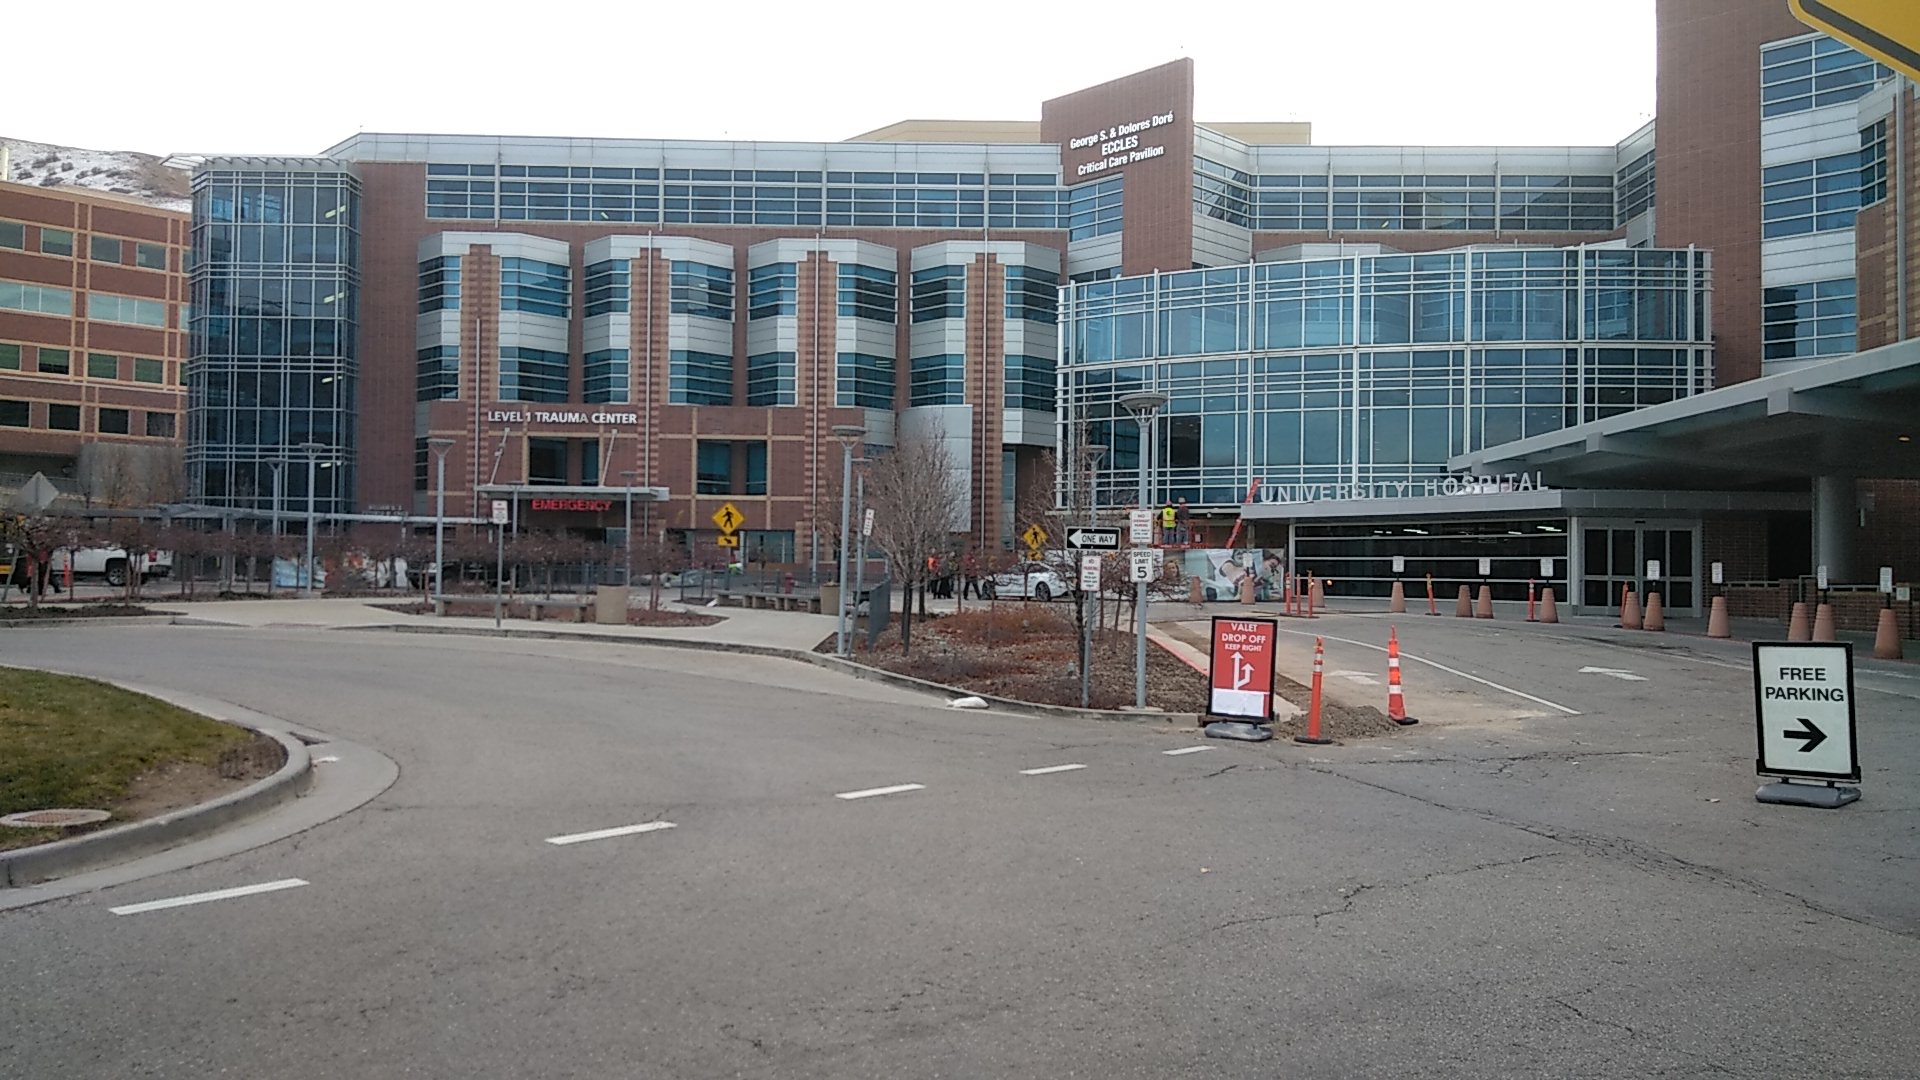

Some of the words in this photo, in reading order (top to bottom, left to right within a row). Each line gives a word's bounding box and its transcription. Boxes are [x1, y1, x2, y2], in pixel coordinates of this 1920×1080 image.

[1070, 134, 1099, 150] George
[1100, 130, 1108, 141] S.
[1110, 127, 1117, 139] &
[1118, 119, 1151, 136] Dolores
[1152, 110, 1174, 127] Doré
[1101, 135, 1139, 156] ECCLES
[1077, 159, 1107, 176] Critical
[1108, 155, 1128, 168] Care
[1130, 145, 1164, 163] Pavilion
[487, 411, 524, 422] LEVEL
[525, 412, 532, 422] 1
[535, 411, 589, 424] TRAUMA
[591, 412, 638, 424] CENTER
[1260, 480, 1409, 503] UNIVERSITY
[1424, 470, 1550, 498] HOSPITAL
[531, 499, 612, 512] EMERGENCY
[1082, 535, 1096, 543] ONE
[1138, 566, 1147, 578] 5
[1231, 623, 1257, 632] VALET
[1222, 633, 1246, 642] DROP
[1249, 635, 1265, 644] OFF
[1779, 667, 1827, 681] FREE
[1765, 686, 1845, 702] PARKING
